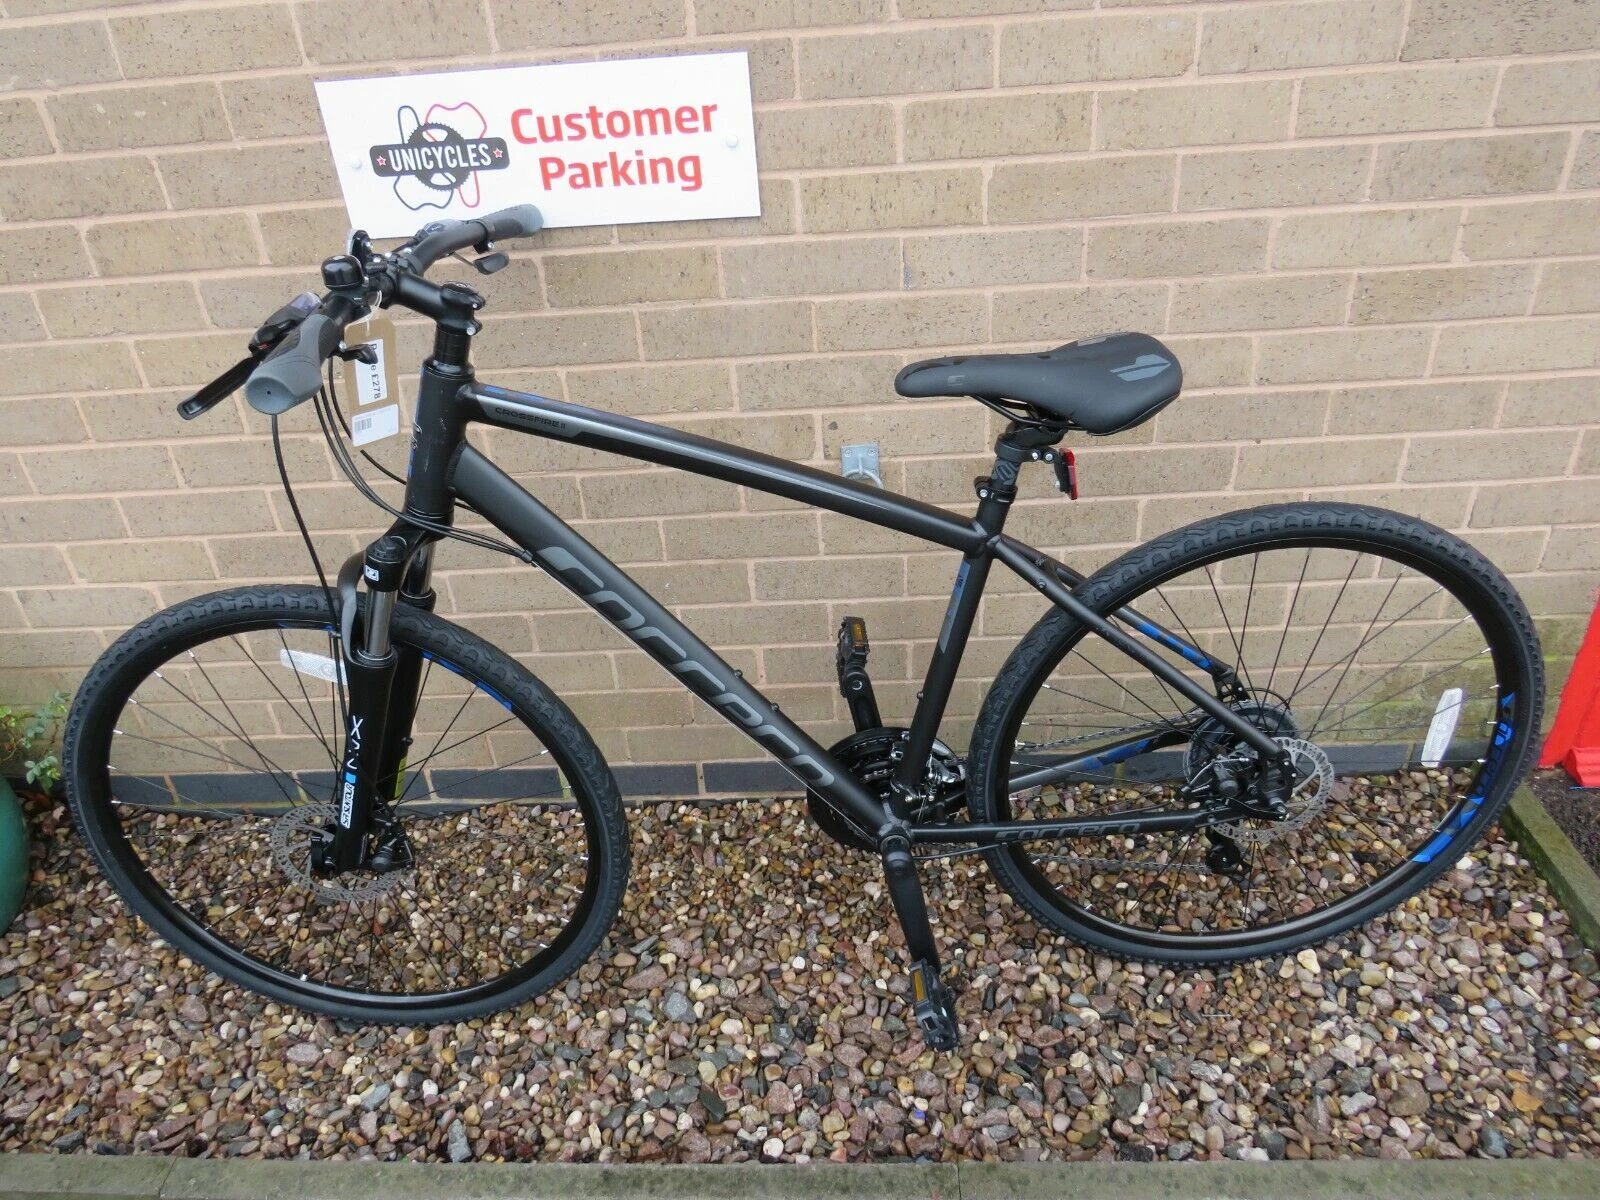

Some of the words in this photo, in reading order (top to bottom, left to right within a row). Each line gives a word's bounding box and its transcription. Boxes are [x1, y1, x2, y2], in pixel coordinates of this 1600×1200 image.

[510, 103, 718, 145] Customer
[387, 142, 493, 172] UNICYCLES
[539, 149, 704, 192] Parking
[371, 374, 382, 400] £278
[495, 407, 560, 428] CROSSFIRE
[538, 546, 835, 786] carrera
[995, 822, 1141, 840] carrera
